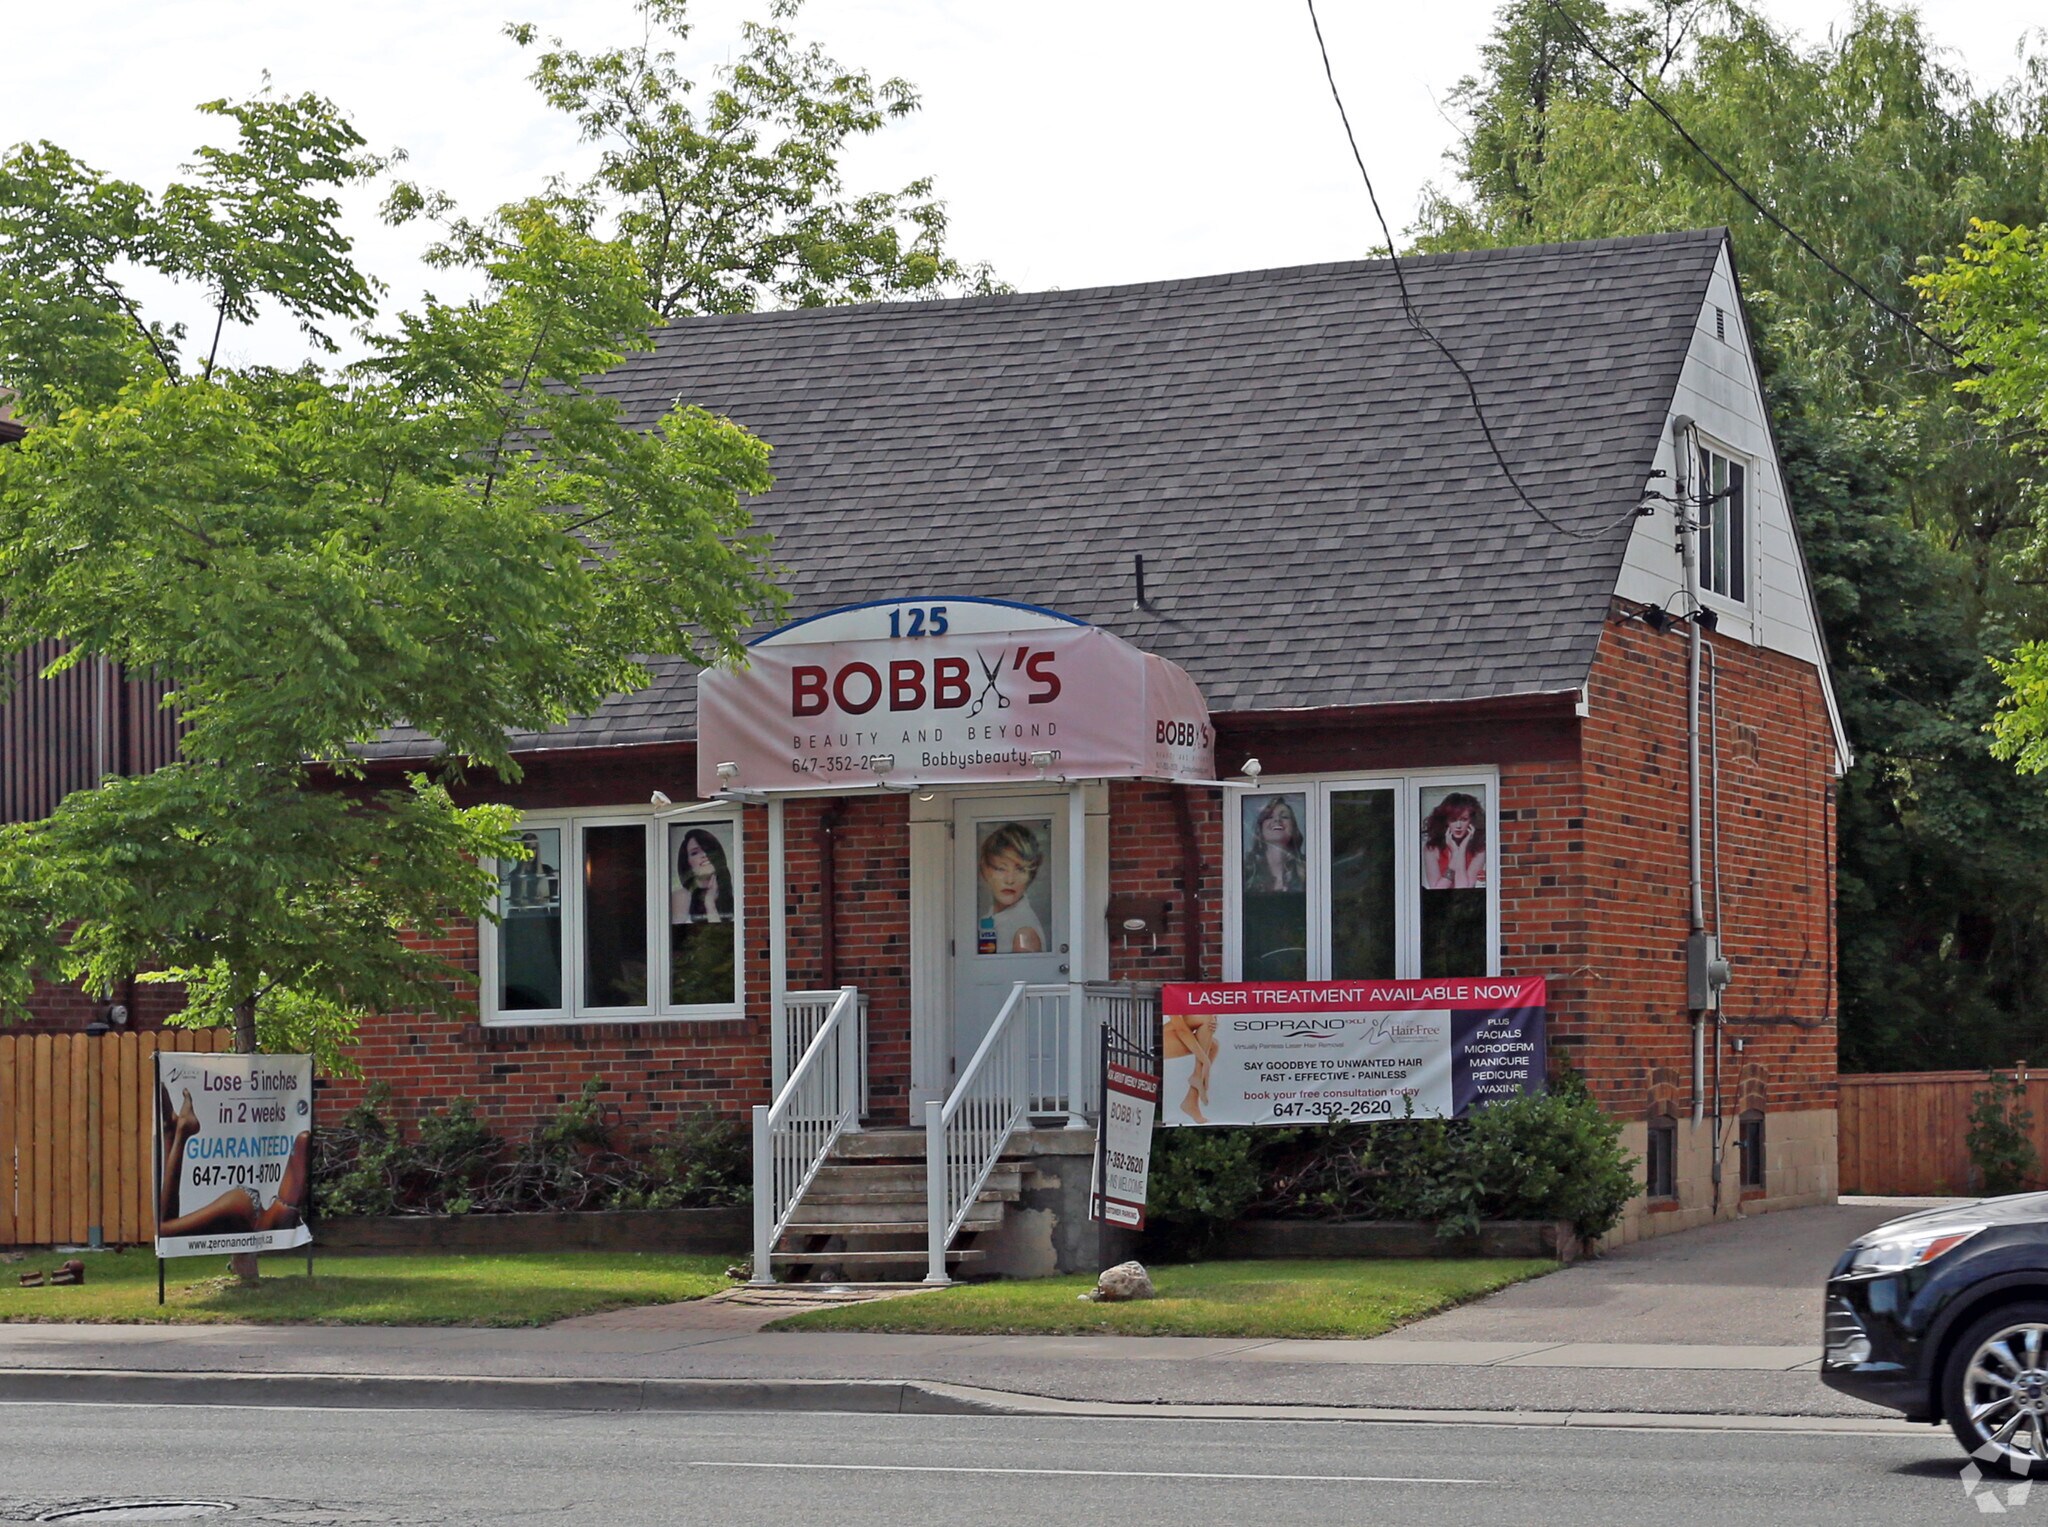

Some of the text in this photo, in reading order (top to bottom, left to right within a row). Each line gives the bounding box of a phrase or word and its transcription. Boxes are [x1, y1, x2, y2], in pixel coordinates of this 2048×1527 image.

[889, 606, 948, 638] 125
[793, 722, 1057, 749] BEAUTY AND BEYOND
[922, 747, 1061, 769] Bobbysbeauty.m
[1188, 985, 1521, 1005] LASER TREATMENT AVAILABLE NOW
[1234, 1019, 1345, 1031] SOPRANO
[1487, 1018, 1510, 1026] PLUS
[1477, 1029, 1522, 1039] FACIALS
[1465, 1043, 1534, 1053] MICRODERM
[1244, 1058, 1423, 1070] SAY GOODBYE TO UNWANTED HAIR
[1470, 1057, 1529, 1067] MANICURE
[204, 1070, 242, 1092] Lose
[262, 1070, 297, 1090] inches
[1260, 1071, 1407, 1082] FAST EFFECTIVE PAINLESS
[1472, 1070, 1528, 1080] PEDICURE
[1244, 1087, 1420, 1101] book your free consultation today
[219, 1101, 285, 1123] in 2 weeks
[1273, 1100, 1391, 1117] 647-352-2620
[187, 1135, 295, 1159] GUARANTEED!
[193, 1163, 281, 1186] 647-701-8700
